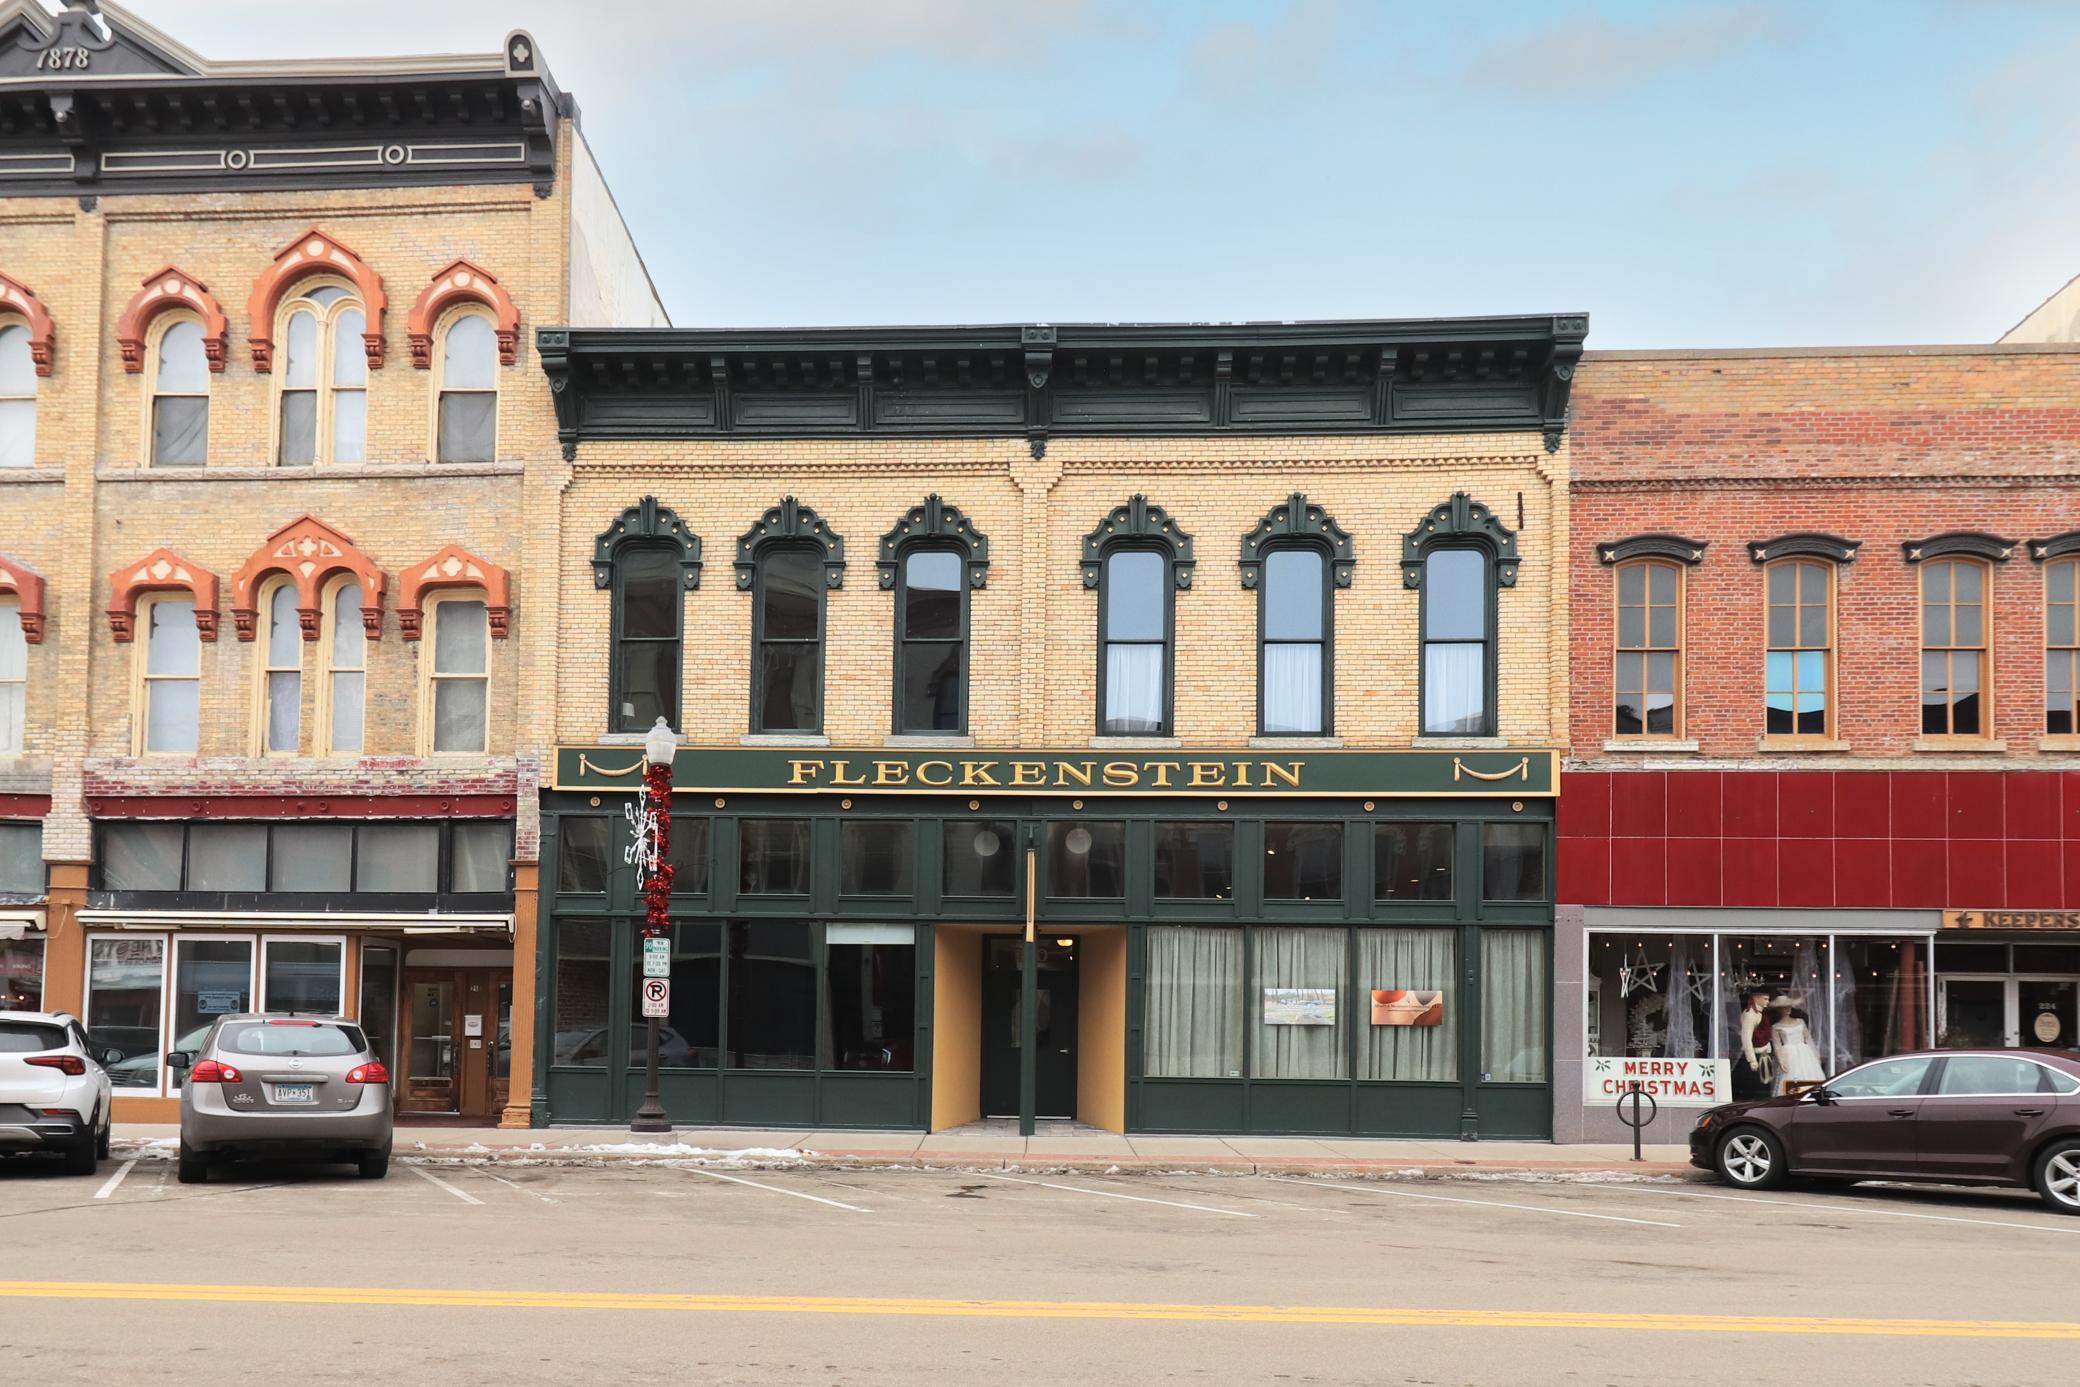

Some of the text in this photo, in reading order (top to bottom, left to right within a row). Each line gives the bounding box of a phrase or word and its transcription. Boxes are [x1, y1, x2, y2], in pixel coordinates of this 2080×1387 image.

[37, 47, 89, 69] 1878
[787, 759, 1305, 787] FLECKENSTEIN
[1983, 911, 2080, 929] KEEPERS
[1624, 1061, 1688, 1075] MERRY
